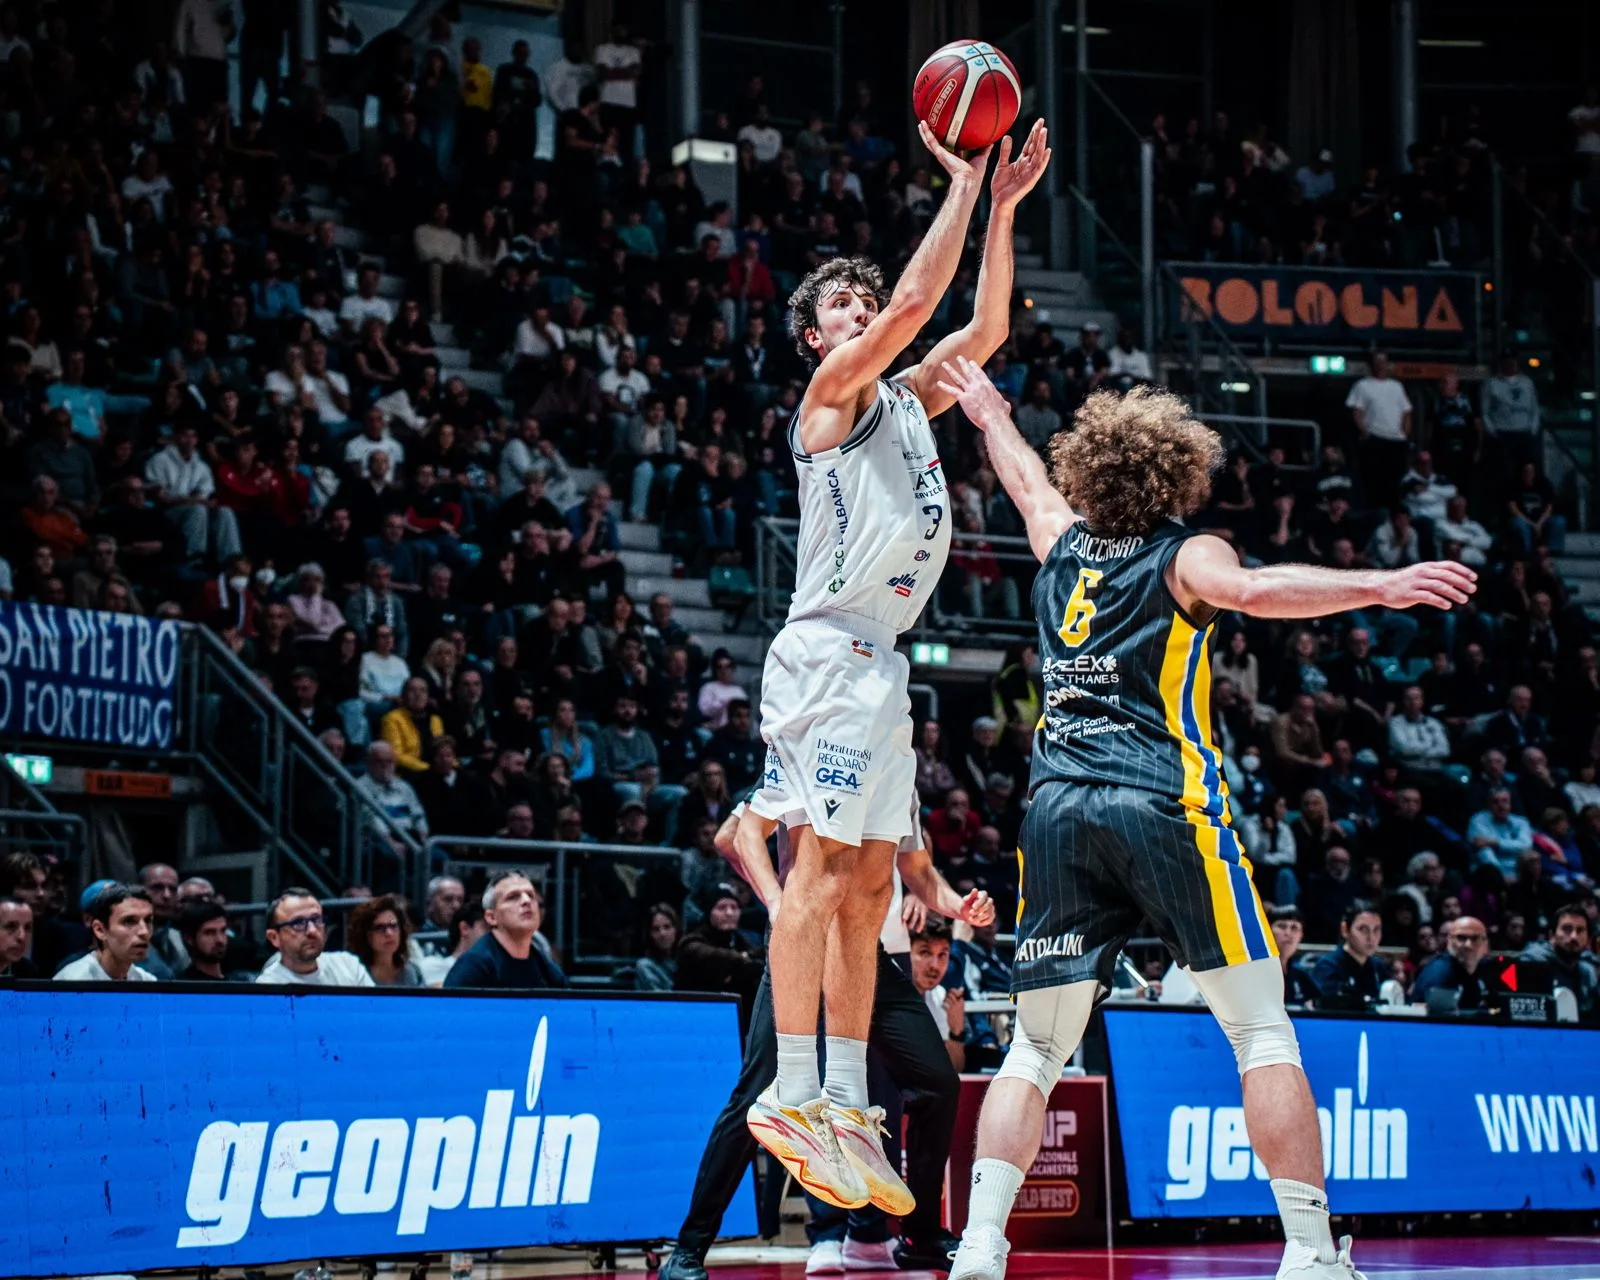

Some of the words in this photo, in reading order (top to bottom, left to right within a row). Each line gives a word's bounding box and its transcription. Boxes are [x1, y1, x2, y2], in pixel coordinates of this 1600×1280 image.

[1180, 276, 1463, 331] BOLOGNA
[922, 504, 943, 540] 3
[1058, 567, 1104, 648] 6
[66, 608, 178, 689] PIETRO
[816, 767, 864, 789] GEA
[817, 752, 868, 773] RECOARO
[176, 1016, 600, 1248] geoplin
[1166, 1031, 1408, 1200] gelin
